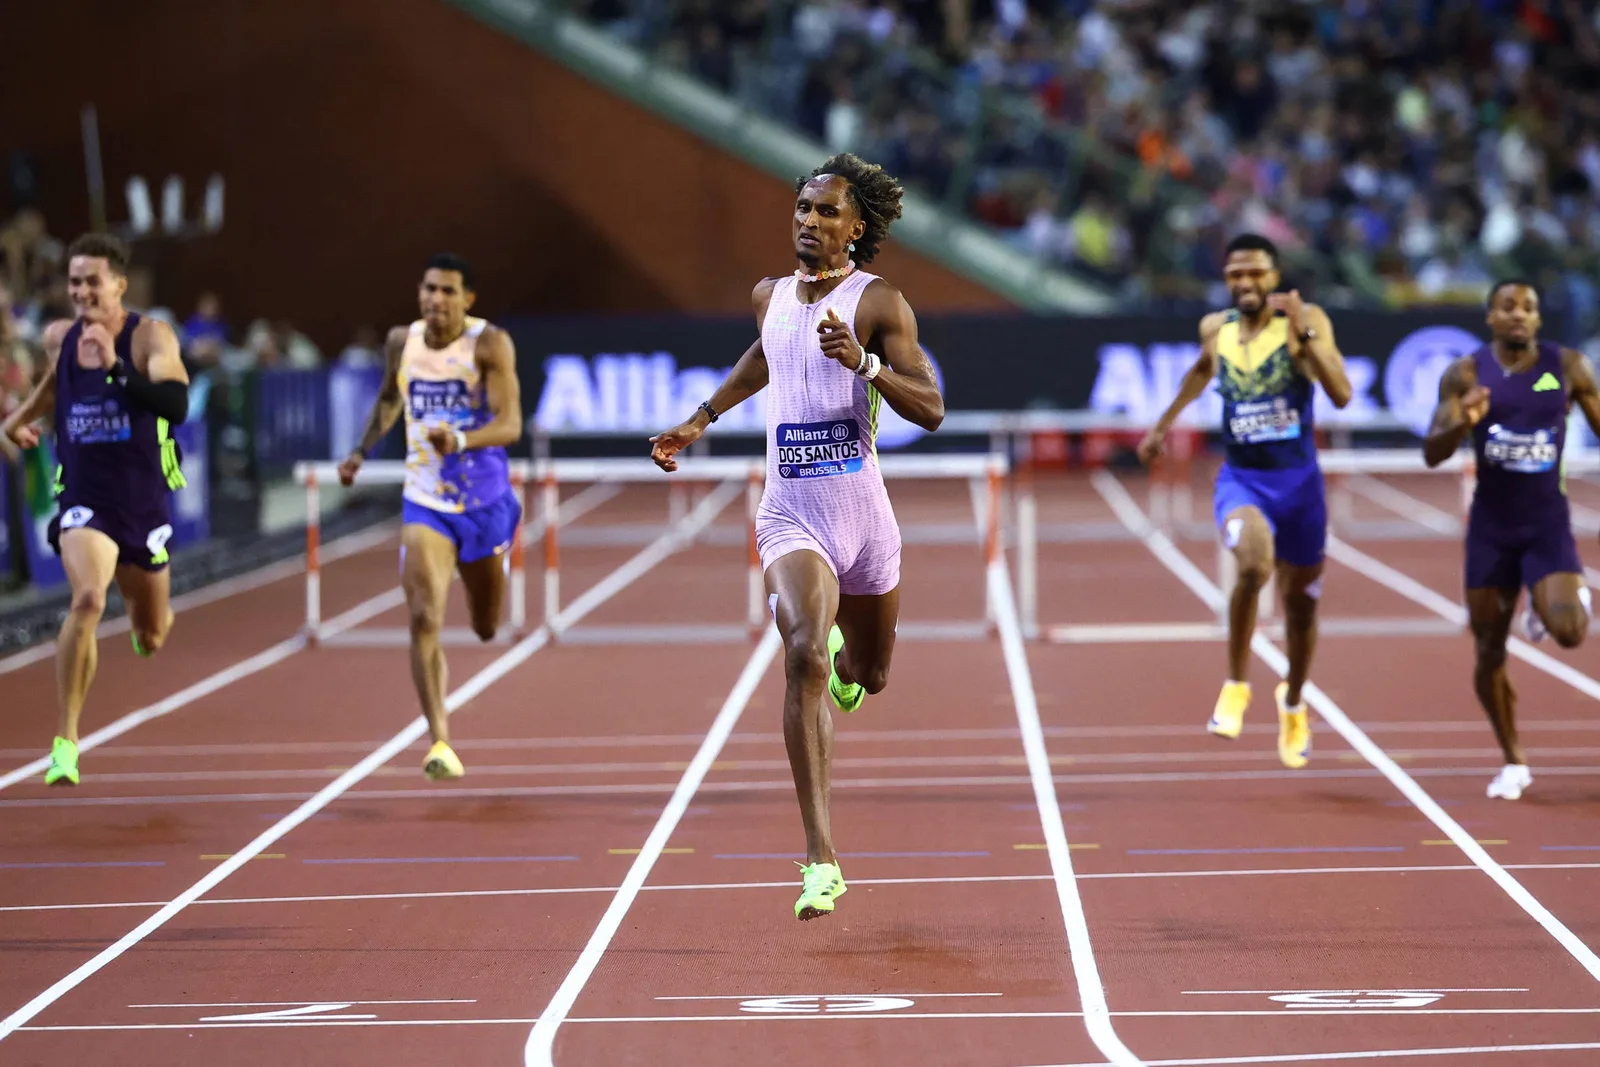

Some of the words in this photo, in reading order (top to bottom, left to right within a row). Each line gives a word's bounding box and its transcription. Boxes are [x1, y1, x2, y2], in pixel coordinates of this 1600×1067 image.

[784, 429, 829, 441] Allianz
[778, 447, 802, 464] DOS
[804, 441, 859, 462] SANTOS
[799, 464, 847, 477] BRUSSELS
